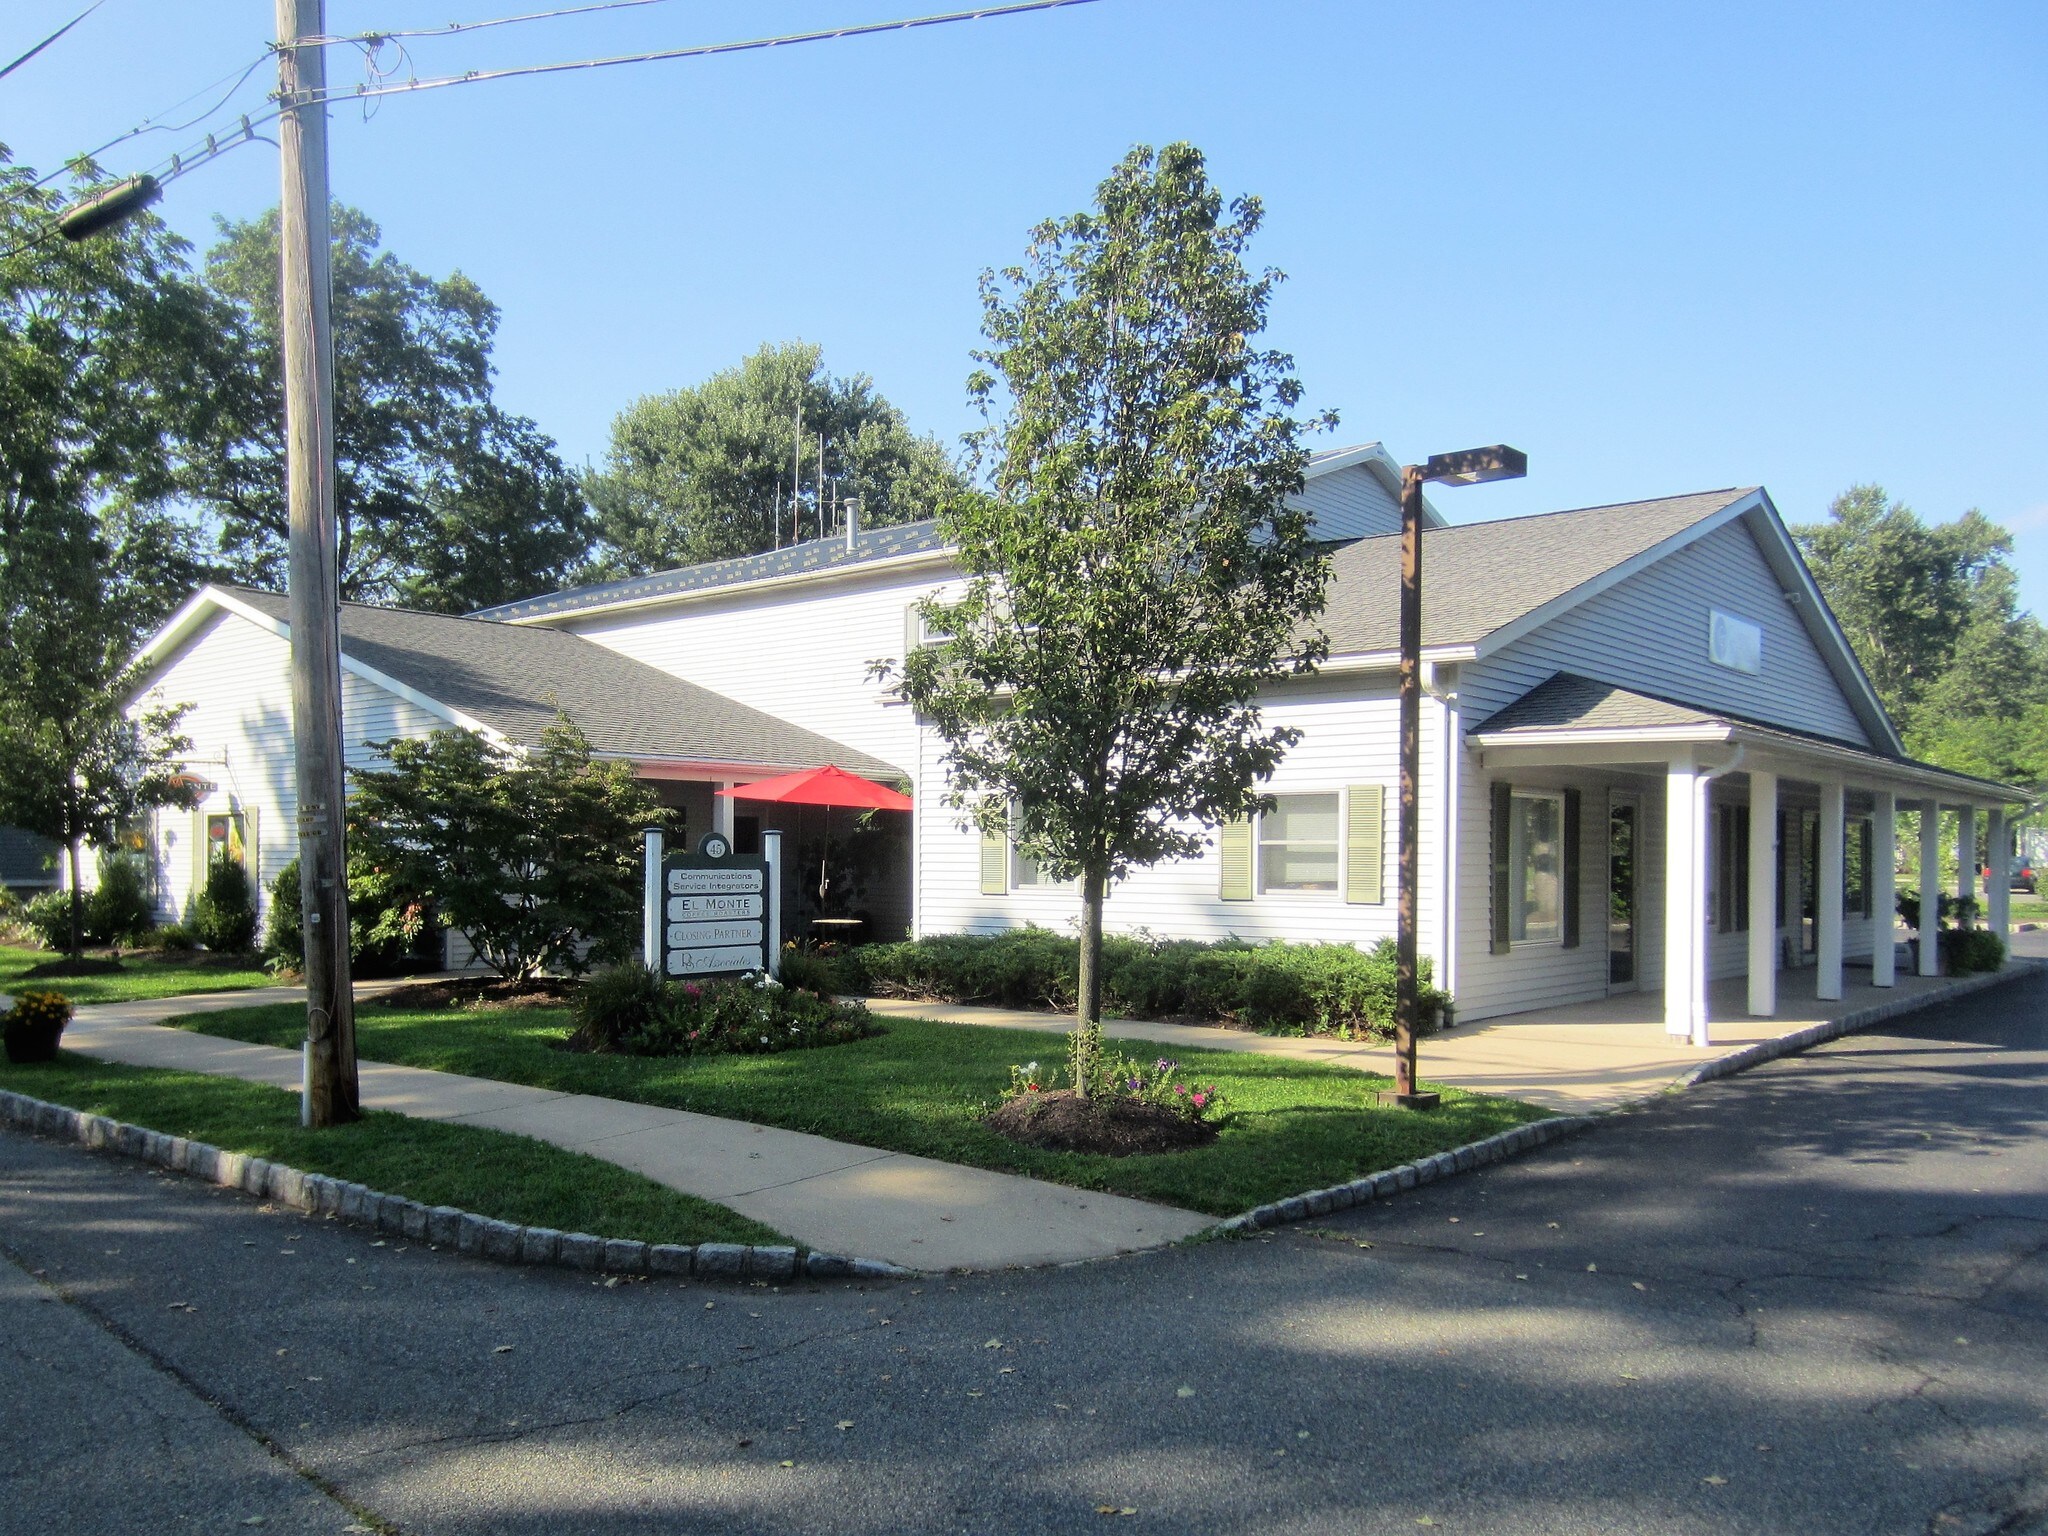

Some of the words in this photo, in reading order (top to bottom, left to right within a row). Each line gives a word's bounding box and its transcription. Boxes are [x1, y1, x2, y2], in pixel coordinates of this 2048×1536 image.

[710, 844, 722, 855] 45
[681, 872, 752, 880] Communications
[673, 882, 706, 890] Service
[709, 882, 759, 891] Integrators
[682, 899, 699, 910] EL
[706, 898, 750, 910] MONTE
[674, 930, 711, 942] CLOSING
[714, 928, 752, 940] PARTNER
